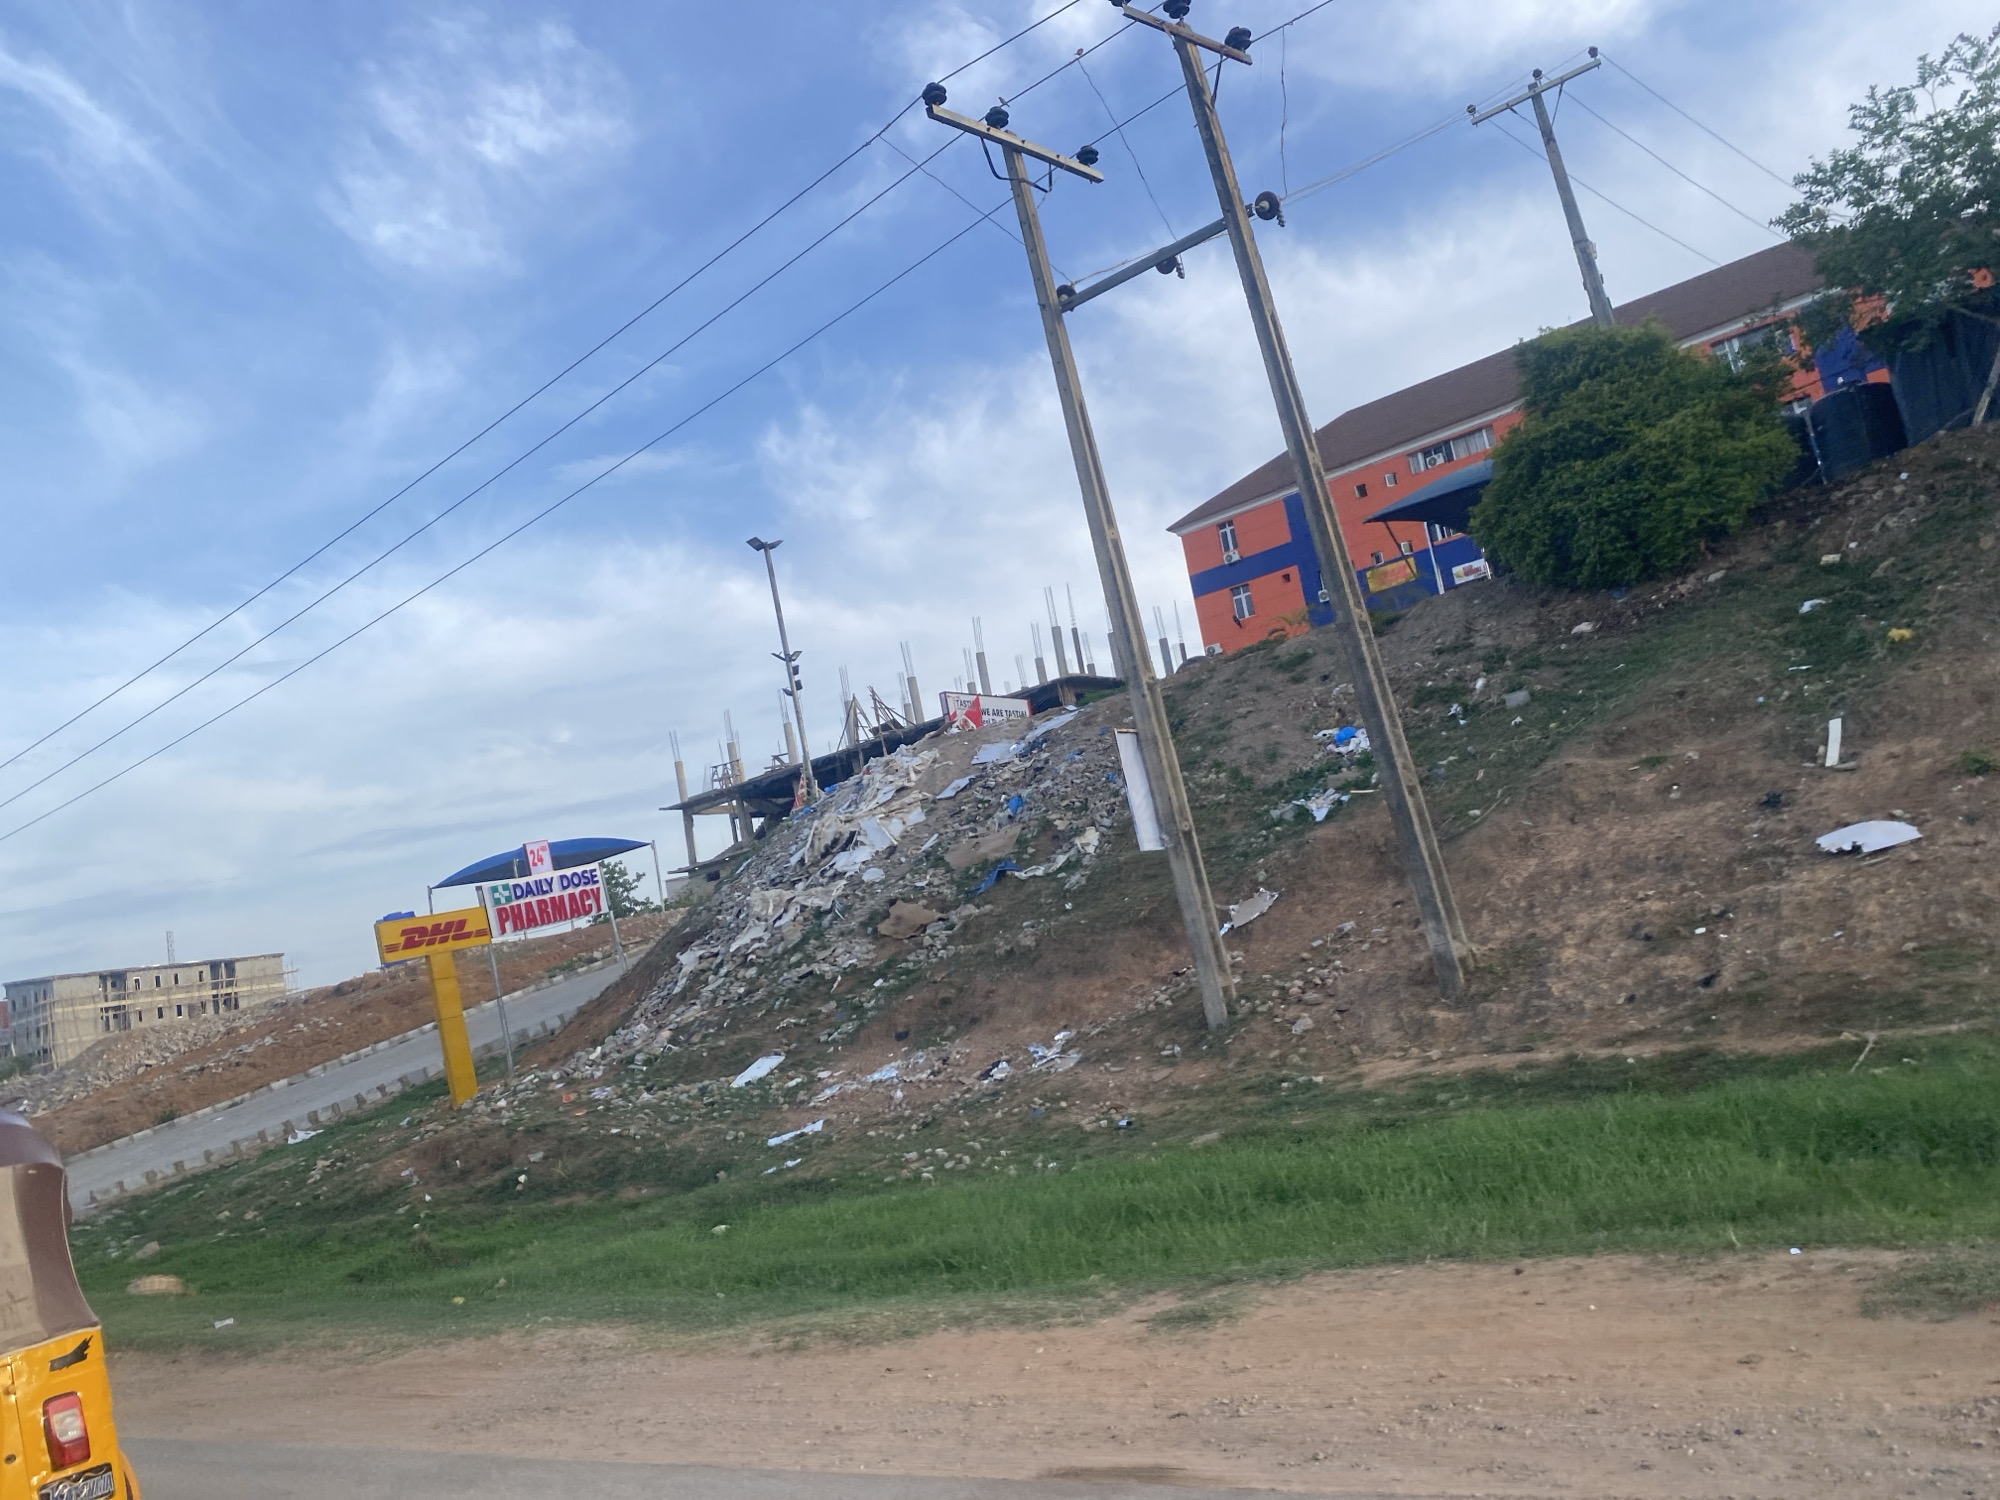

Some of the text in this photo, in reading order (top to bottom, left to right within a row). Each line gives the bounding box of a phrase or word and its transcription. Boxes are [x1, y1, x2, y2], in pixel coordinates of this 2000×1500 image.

[981, 708, 990, 716] WE
[992, 708, 1004, 717] ARE
[529, 849, 544, 867] 24
[512, 868, 599, 900] DAILY DOSE
[496, 886, 602, 935] PHARMACY
[400, 918, 474, 950] DHL
